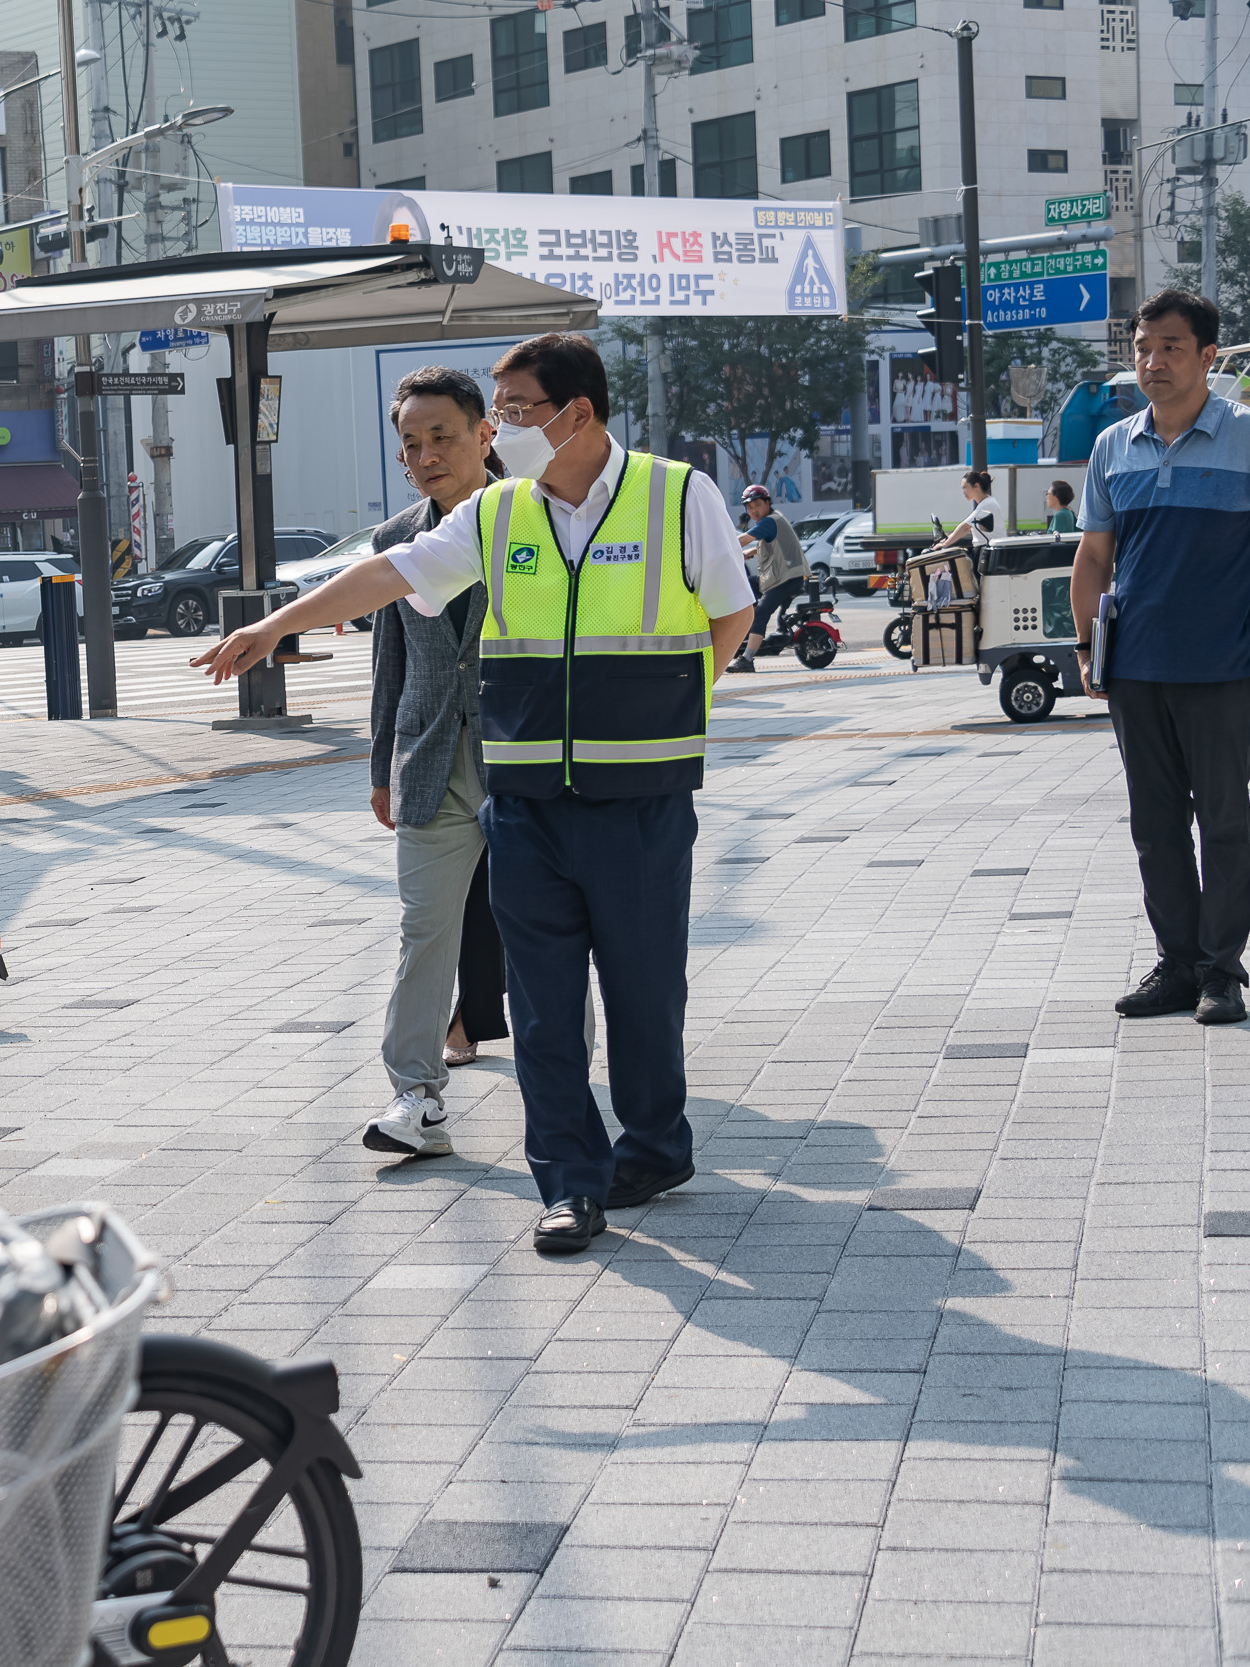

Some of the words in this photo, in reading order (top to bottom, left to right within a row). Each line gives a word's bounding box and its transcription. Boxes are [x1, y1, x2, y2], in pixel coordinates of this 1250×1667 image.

[1047, 196, 1103, 221] 자양사거리
[999, 260, 1043, 279] 잠실대교
[1047, 254, 1092, 274] 건대입구역
[986, 283, 1046, 306] 아차산로
[201, 301, 241, 317] 광진구
[986, 306, 1047, 323] Achasan-ro
[605, 552, 640, 563] 광진구청장
[509, 563, 534, 572] 광진구
